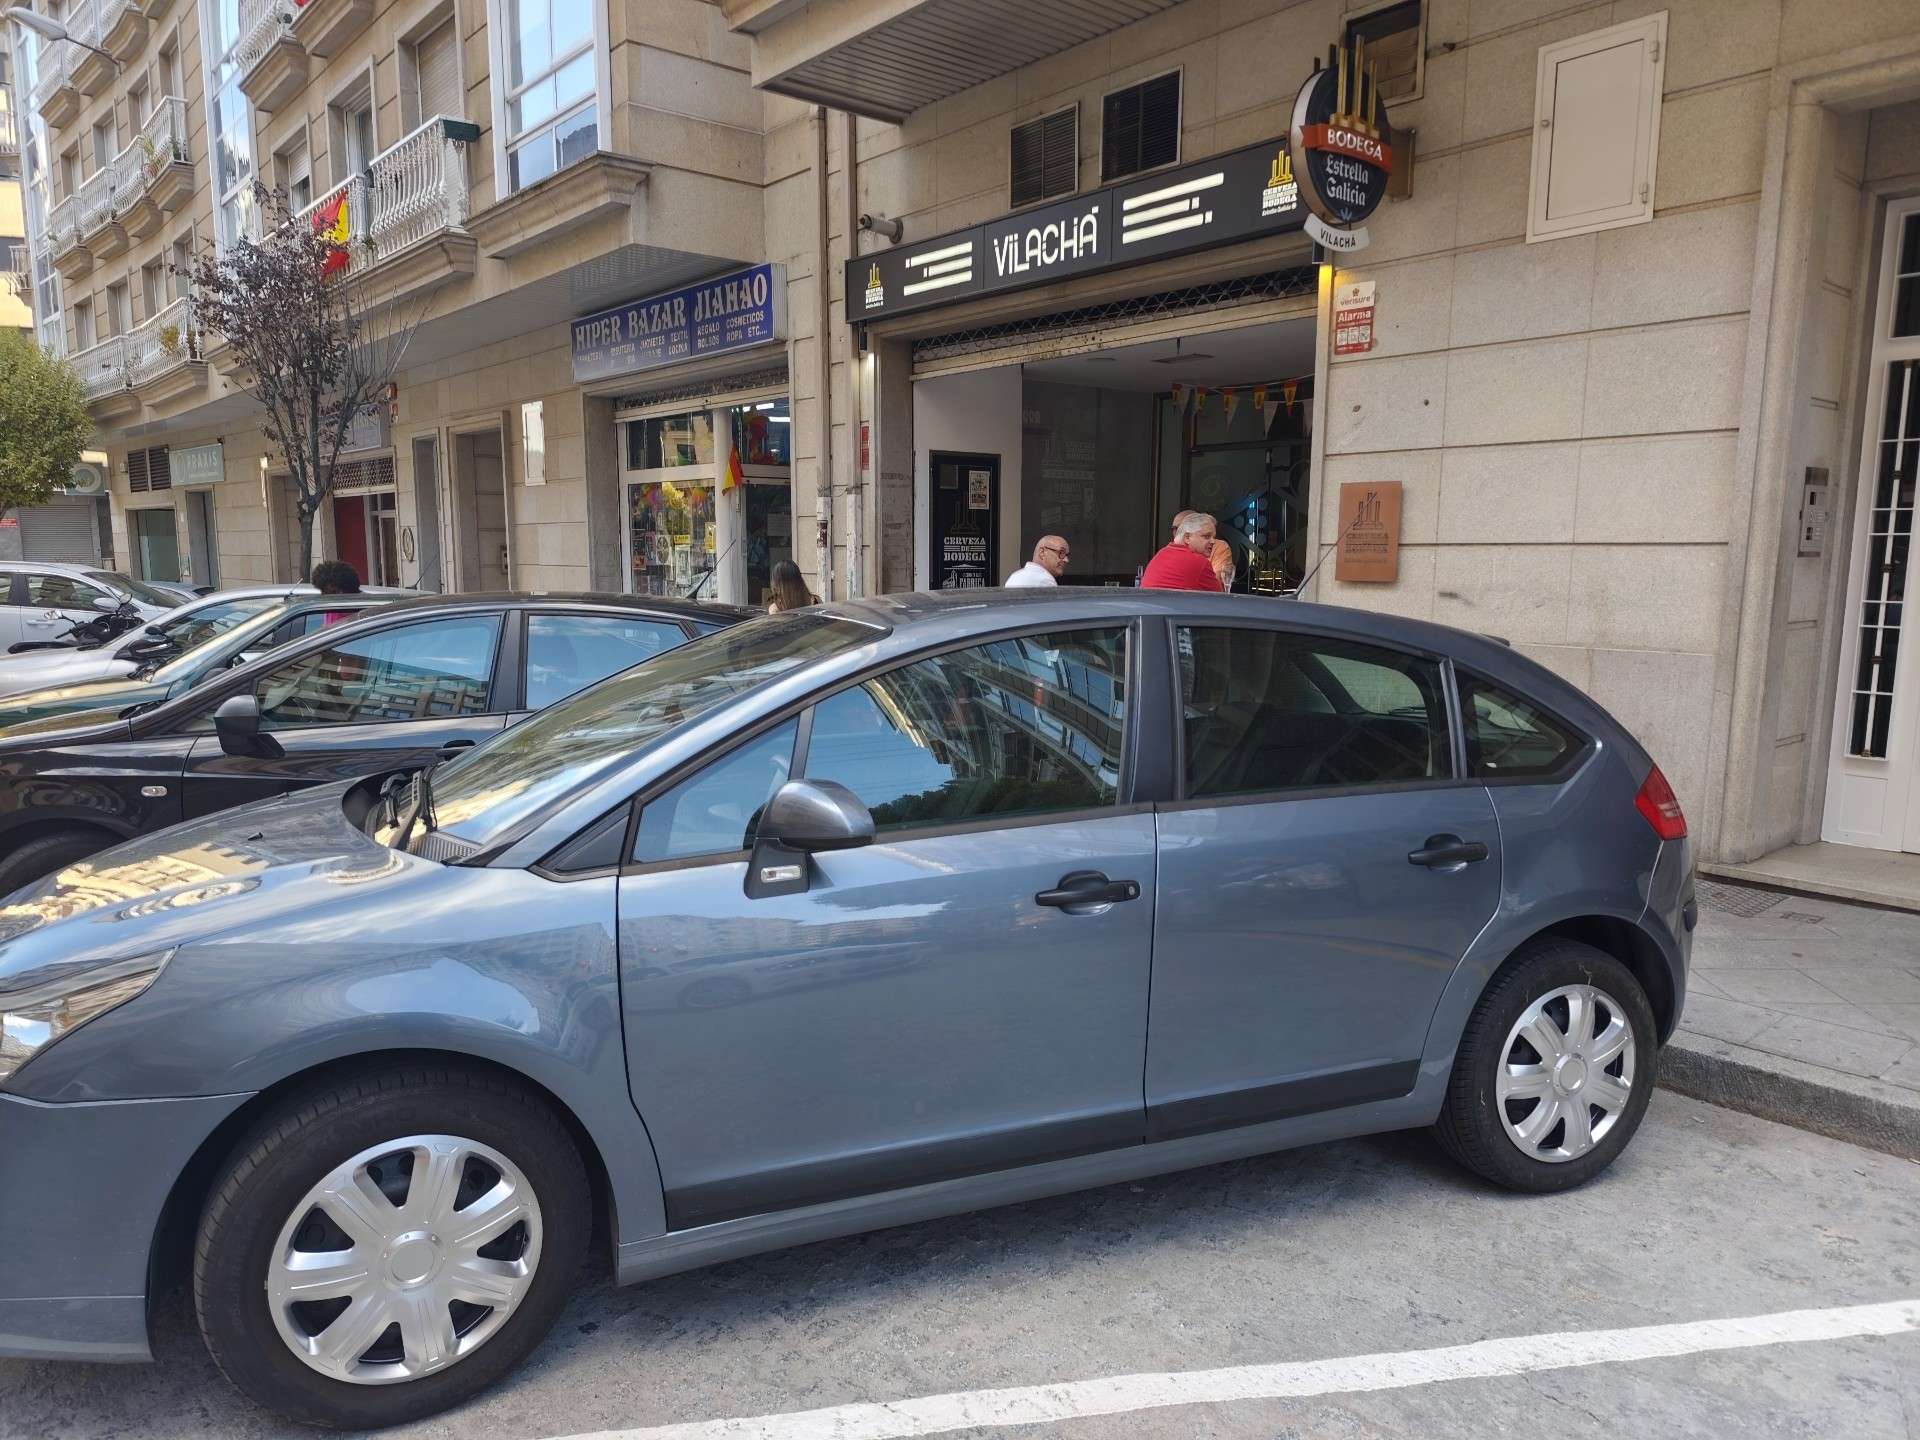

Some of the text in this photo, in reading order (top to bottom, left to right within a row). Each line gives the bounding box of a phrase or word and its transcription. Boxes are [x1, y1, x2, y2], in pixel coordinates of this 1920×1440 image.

[1327, 128, 1383, 161] BODEGA
[1325, 154, 1369, 184] Estrella
[1326, 177, 1366, 206] Galicia
[575, 273, 767, 350] HIPER BAZAR JIAHAO
[697, 322, 720, 336] REGALO
[726, 310, 764, 329] COSMETICOS
[1338, 310, 1371, 323] Alarma
[726, 329, 743, 343] ROPA
[943, 536, 987, 545] CERVEZA
[943, 552, 986, 561] BODEGA
